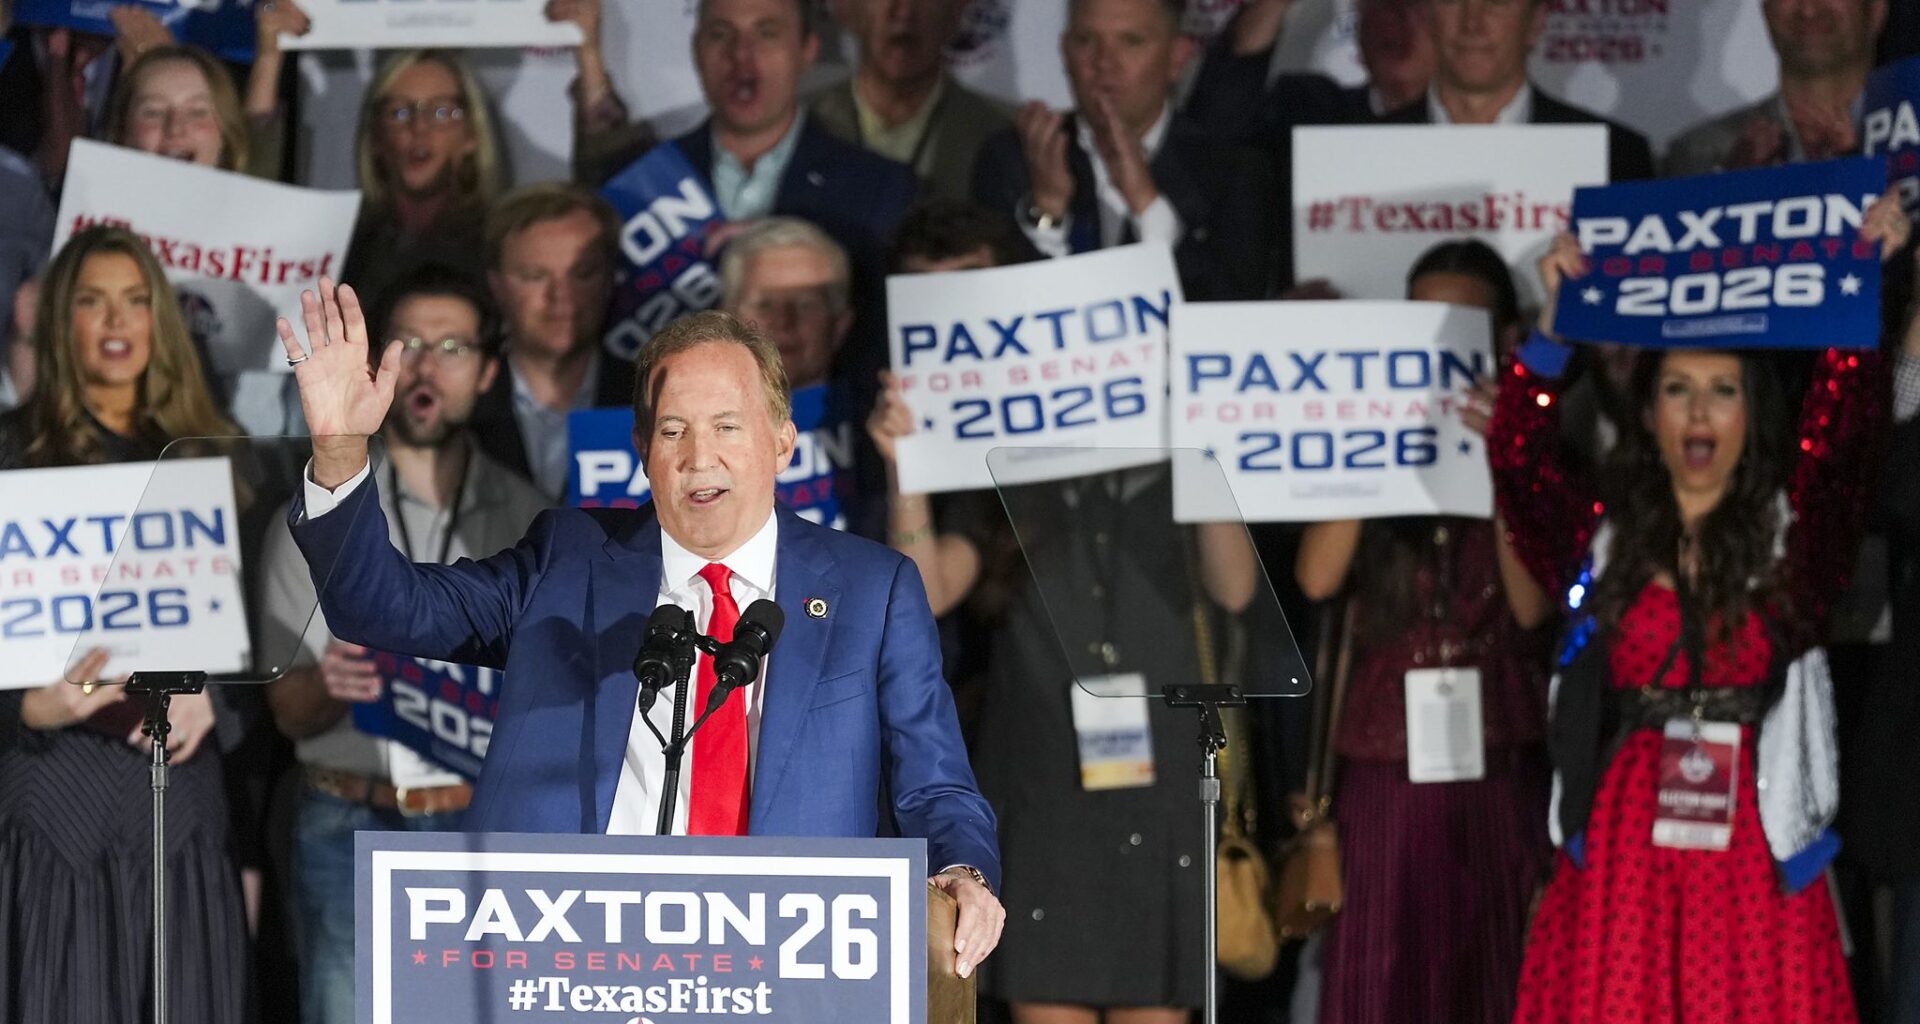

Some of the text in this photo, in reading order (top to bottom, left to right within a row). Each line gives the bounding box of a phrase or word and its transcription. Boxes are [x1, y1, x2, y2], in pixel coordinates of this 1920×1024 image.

[1577, 194, 1880, 255] PAXTON
[1690, 239, 1875, 272] SENATE
[1615, 262, 1826, 316] 2026
[900, 289, 1171, 367] PAXTON
[1007, 343, 1155, 387] SENAT
[1185, 349, 1484, 393] PAXTON
[952, 376, 1147, 440] 2026
[1185, 398, 1457, 423] FOR SENAT
[1238, 427, 1439, 472] 2026
[0, 507, 226, 559] AXTON
[60, 556, 234, 588] SENATE
[0, 588, 190, 640] 2026
[390, 680, 494, 760] 202
[405, 887, 878, 980] PAXTON 26
[442, 950, 733, 973] FOR SENATE
[508, 975, 773, 1015] #TexasFirst
